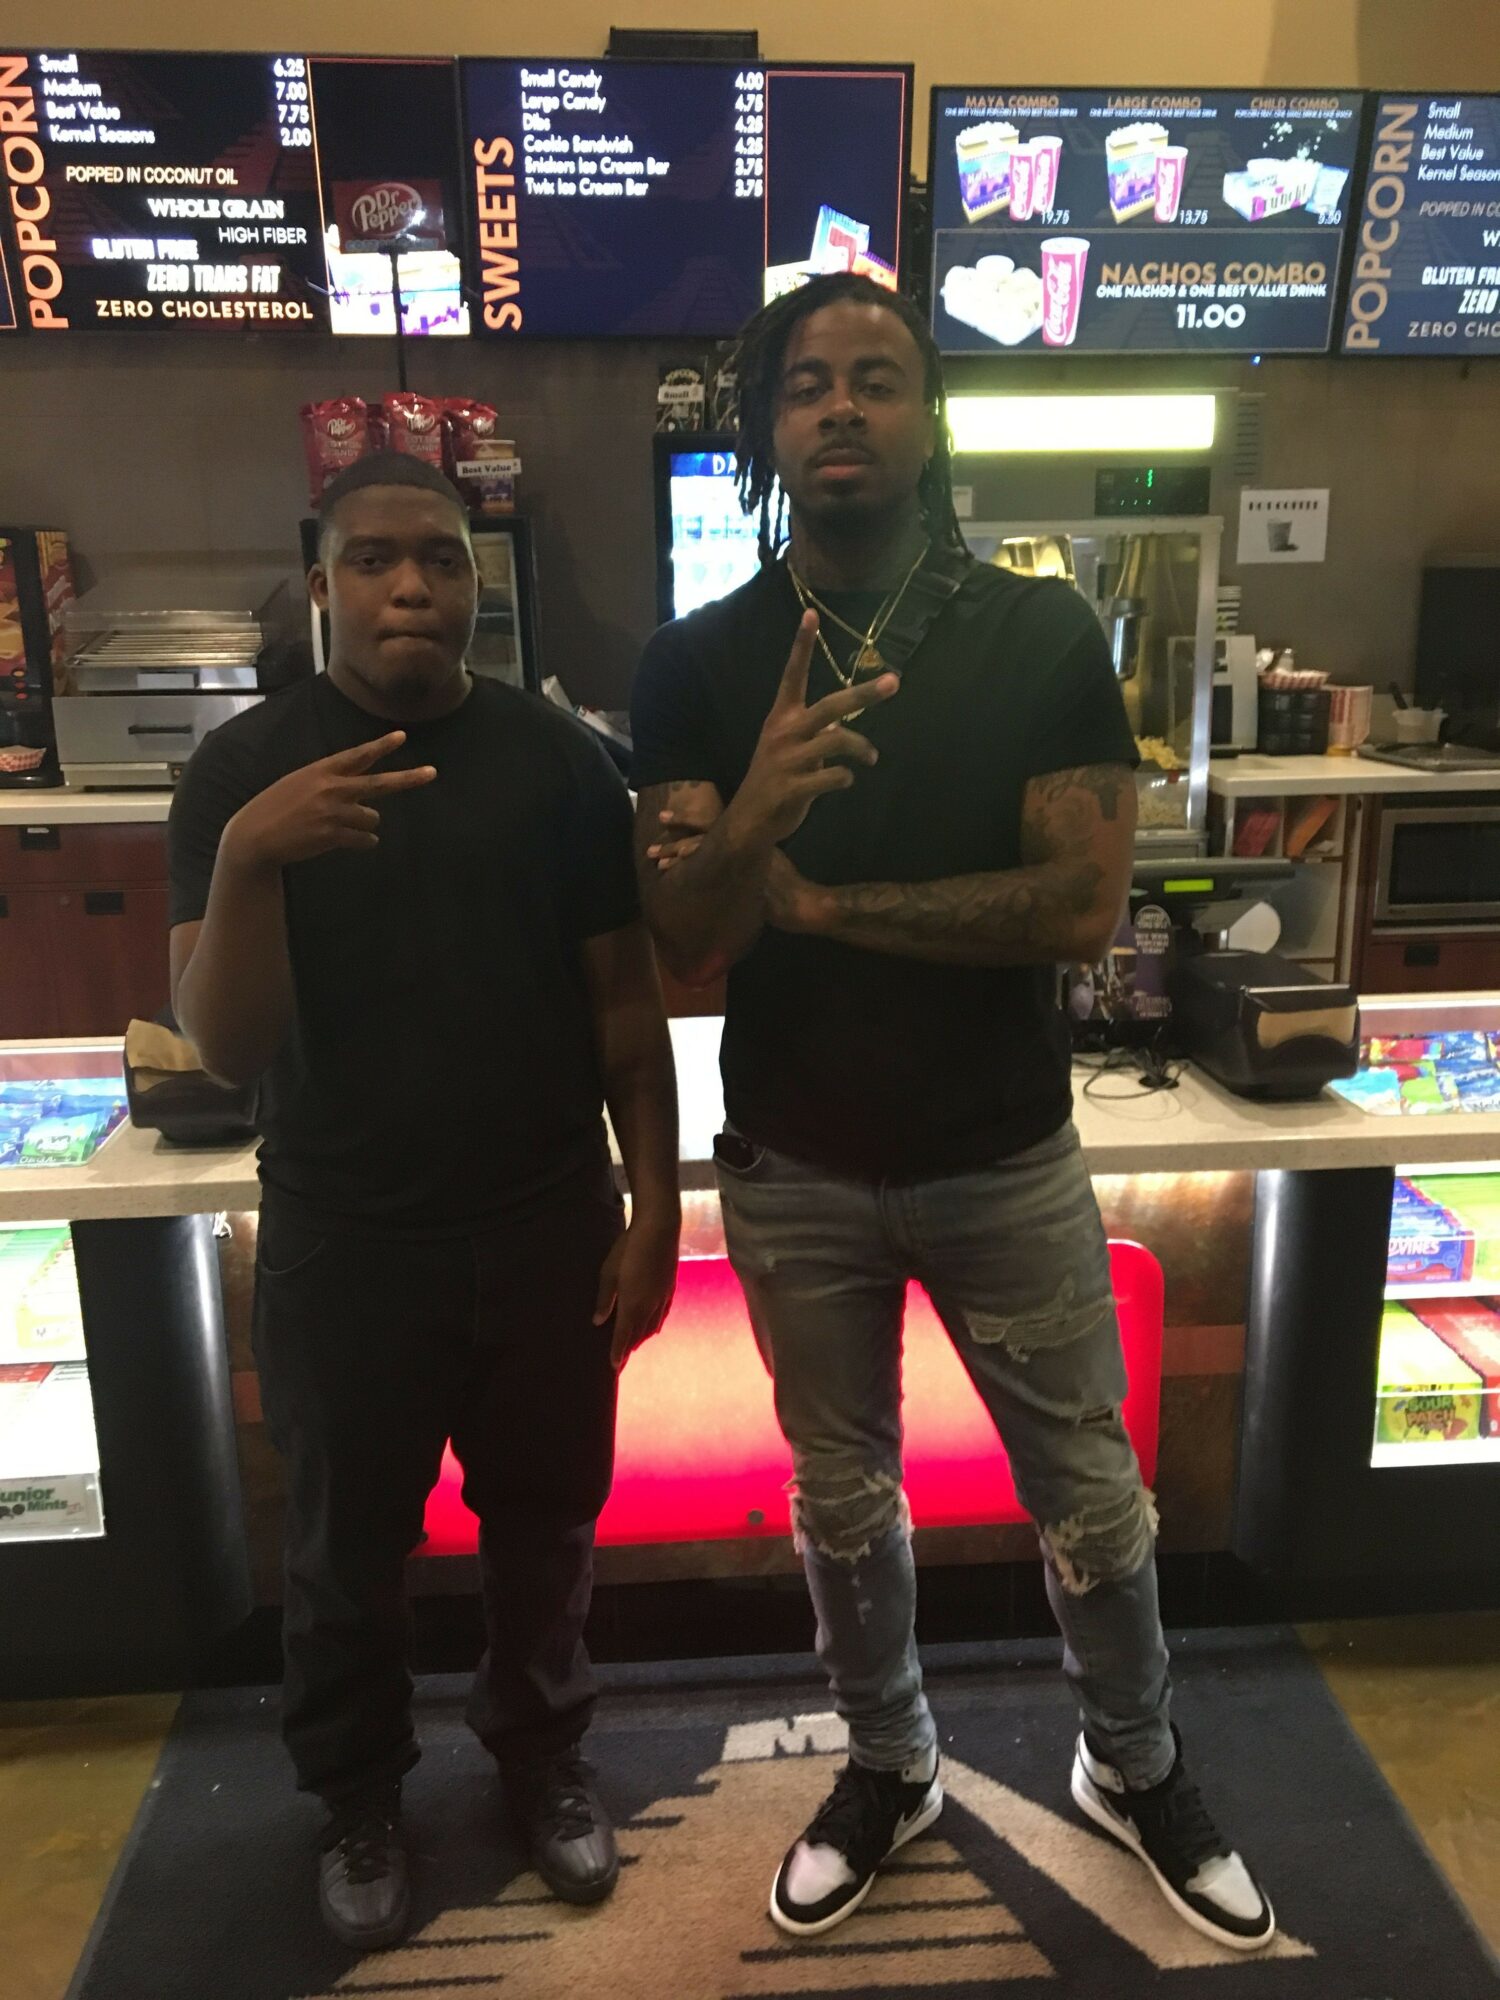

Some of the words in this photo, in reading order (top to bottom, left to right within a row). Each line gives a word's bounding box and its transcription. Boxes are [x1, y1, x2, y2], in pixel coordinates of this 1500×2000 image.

[39, 54, 79, 73] Small
[273, 58, 305, 77] 6.25
[43, 77, 101, 97] Medium
[521, 69, 555, 88] Small
[557, 69, 603, 92] Candy
[734, 72, 764, 91] 4.00
[275, 81, 307, 101] 7.00
[46, 101, 76, 119] Best
[78, 101, 120, 120] Value
[522, 91, 561, 113] Large
[562, 91, 606, 113] Candy
[734, 94, 764, 112] 4.75
[965, 96, 1004, 108] MAYA
[1008, 96, 1059, 108] COMBO
[1107, 96, 1148, 108] LARGE
[1151, 96, 1202, 109] COMBO
[1289, 97, 1339, 110] COMBO
[1427, 101, 1461, 119] Small
[277, 104, 309, 124] 7.75
[49, 123, 96, 142] Kernel
[98, 124, 155, 144] Seasons
[281, 127, 311, 147] 2.00
[1424, 122, 1474, 140] Medium
[1421, 143, 1447, 160] Best
[1449, 143, 1484, 161] Value
[66, 165, 123, 183] POPPED
[126, 166, 141, 183] IN
[143, 166, 214, 184] COCONUT
[215, 167, 239, 185] OIL
[577, 156, 598, 176] Ice
[600, 156, 645, 176] Cream
[646, 156, 669, 176] Bar
[1418, 163, 1458, 181] Kernel
[0, 54, 69, 330] POPCORN
[525, 177, 556, 197] Twix
[557, 177, 577, 197] Ice
[579, 177, 624, 197] Cream
[625, 177, 649, 197] Bar
[147, 198, 221, 218] WHOLE
[222, 199, 285, 219] GRAIN
[375, 189, 400, 211] Dr
[1419, 200, 1470, 217] POPPED
[1471, 201, 1485, 217] IN
[359, 194, 418, 232] Pepper
[218, 227, 259, 243] HIGH
[263, 227, 307, 244] FIBER
[474, 136, 522, 332] SWEETS
[1345, 103, 1419, 350] POPCORN
[147, 264, 190, 291] ZERO
[251, 265, 281, 293] FAT
[1101, 262, 1216, 284] NACHOS
[1223, 262, 1326, 285] COMBO
[1422, 265, 1476, 285] GLUTEN
[1096, 284, 1122, 298] ONE
[1124, 284, 1176, 298] NACHOS
[1178, 284, 1187, 298] &
[1189, 284, 1215, 298] ONE
[1217, 284, 1246, 298] BEST
[1249, 284, 1288, 298] VALUE
[1289, 284, 1327, 298] DRINK
[1458, 288, 1499, 314] ZERO
[96, 300, 153, 317] ZERO
[161, 301, 314, 319] CHOLESTEROL
[1176, 303, 1247, 329] 11.00
[1407, 321, 1457, 337] ZERO
[27, 1499, 69, 1512] Mints
